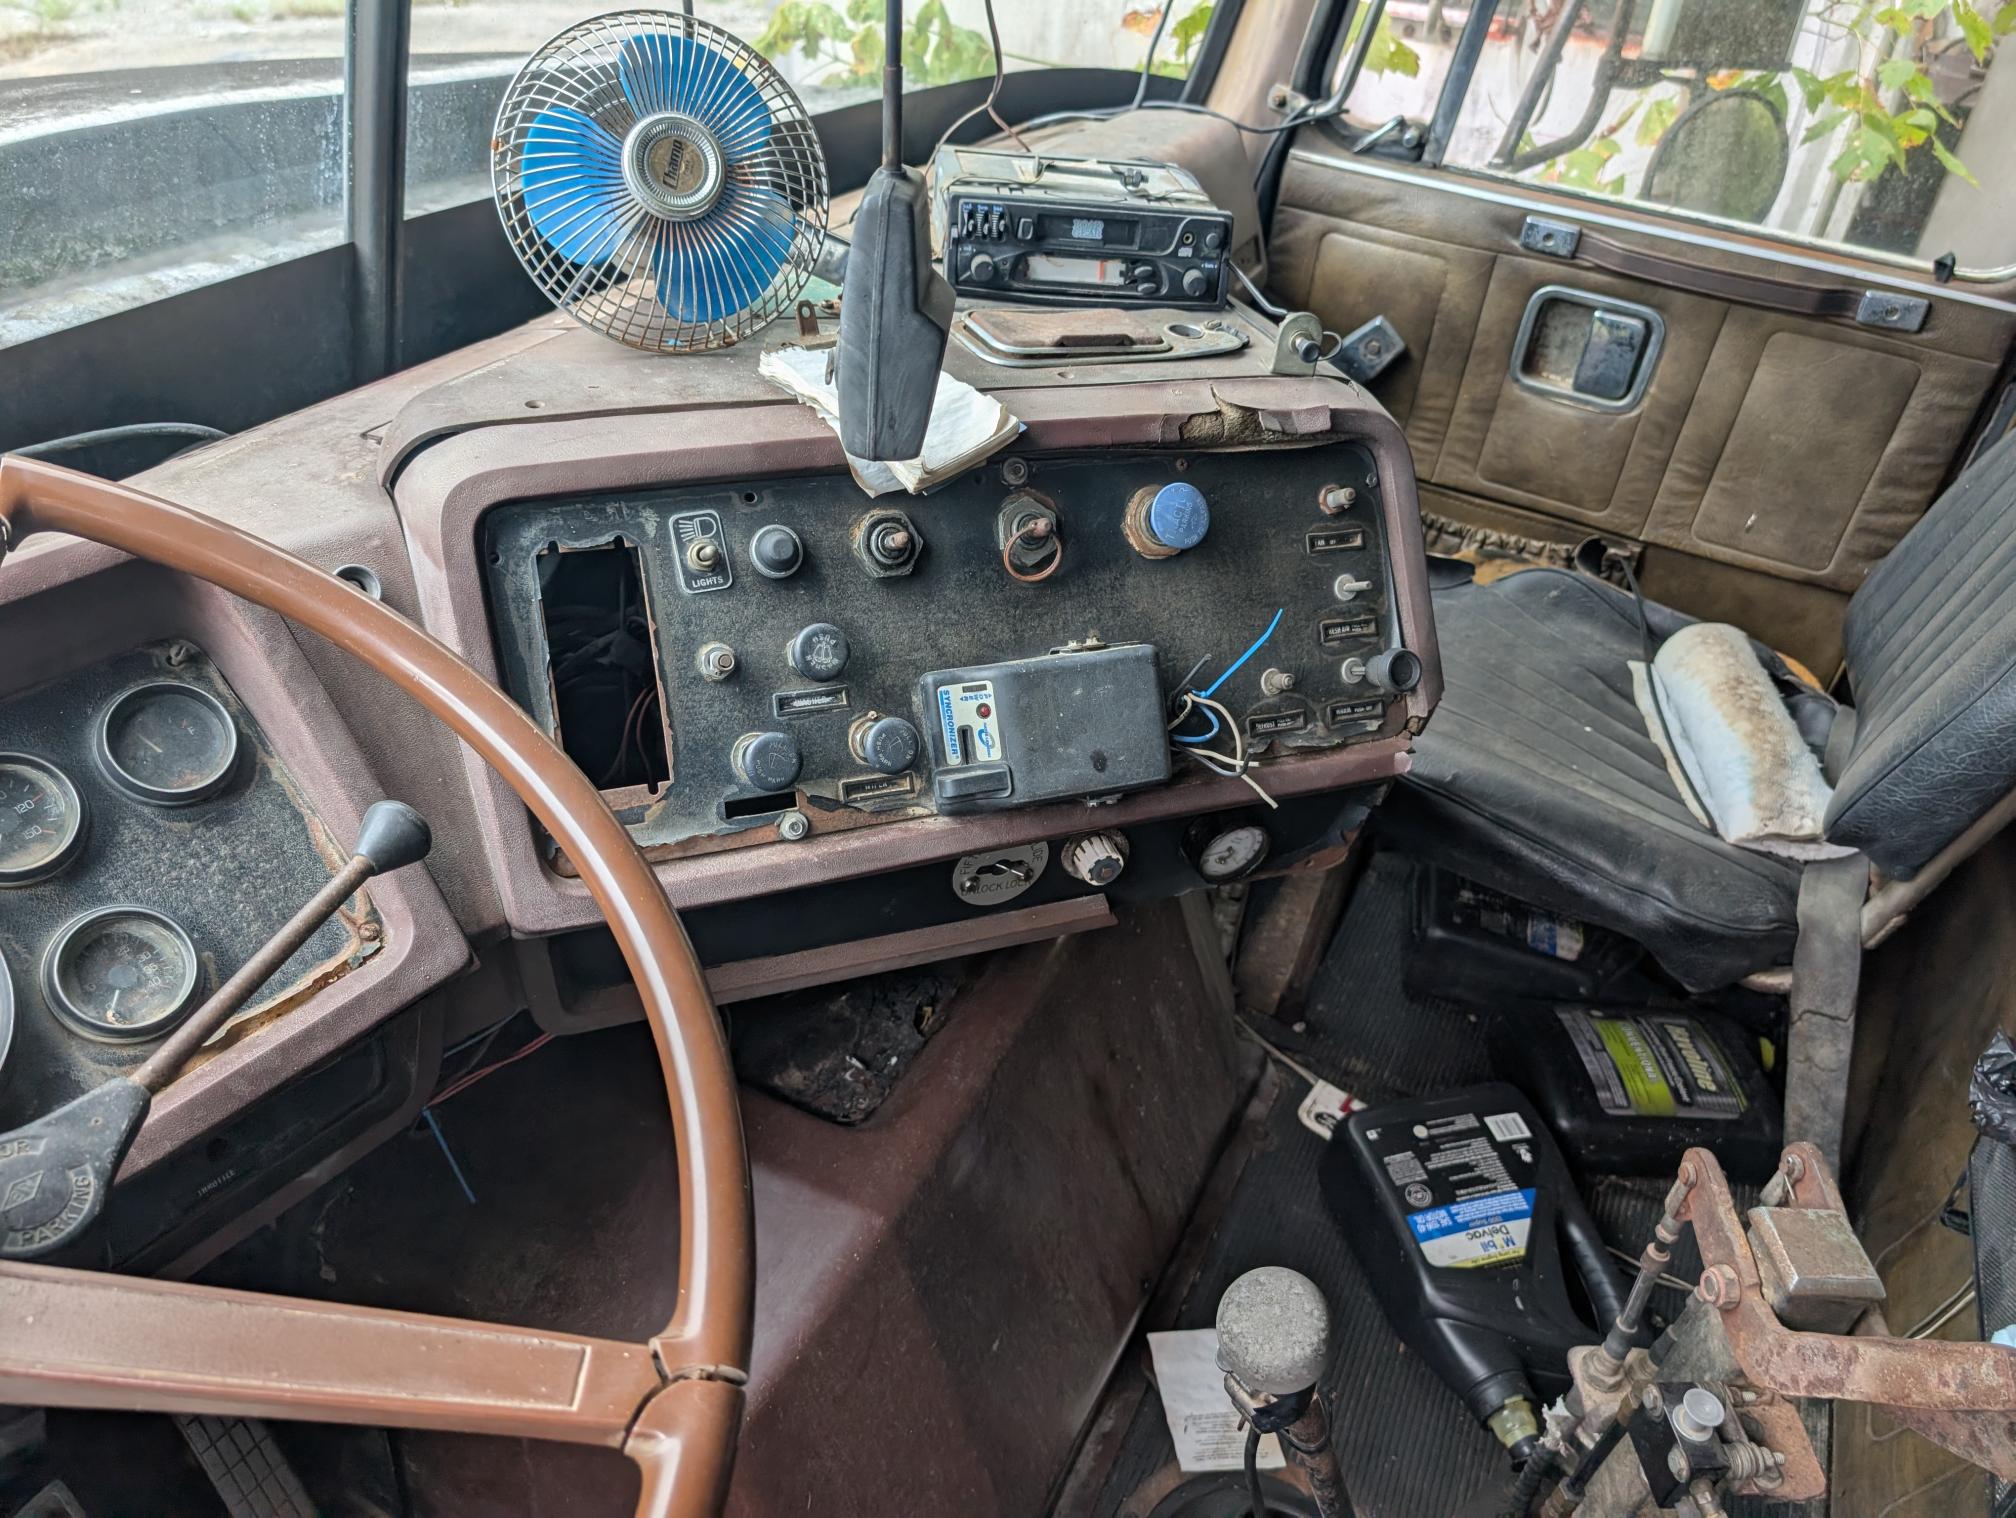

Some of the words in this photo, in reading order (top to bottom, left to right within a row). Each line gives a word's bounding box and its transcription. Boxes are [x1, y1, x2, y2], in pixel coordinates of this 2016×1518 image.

[691, 575, 724, 588] LIGHTS
[943, 689, 959, 756] SYNCRONIZER
[14, 799, 35, 815] 120
[23, 825, 42, 840] 150
[19, 1176, 92, 1248] PARKING
[1465, 1223, 1510, 1241] Delvac
[1479, 1234, 1517, 1253] Mbil
